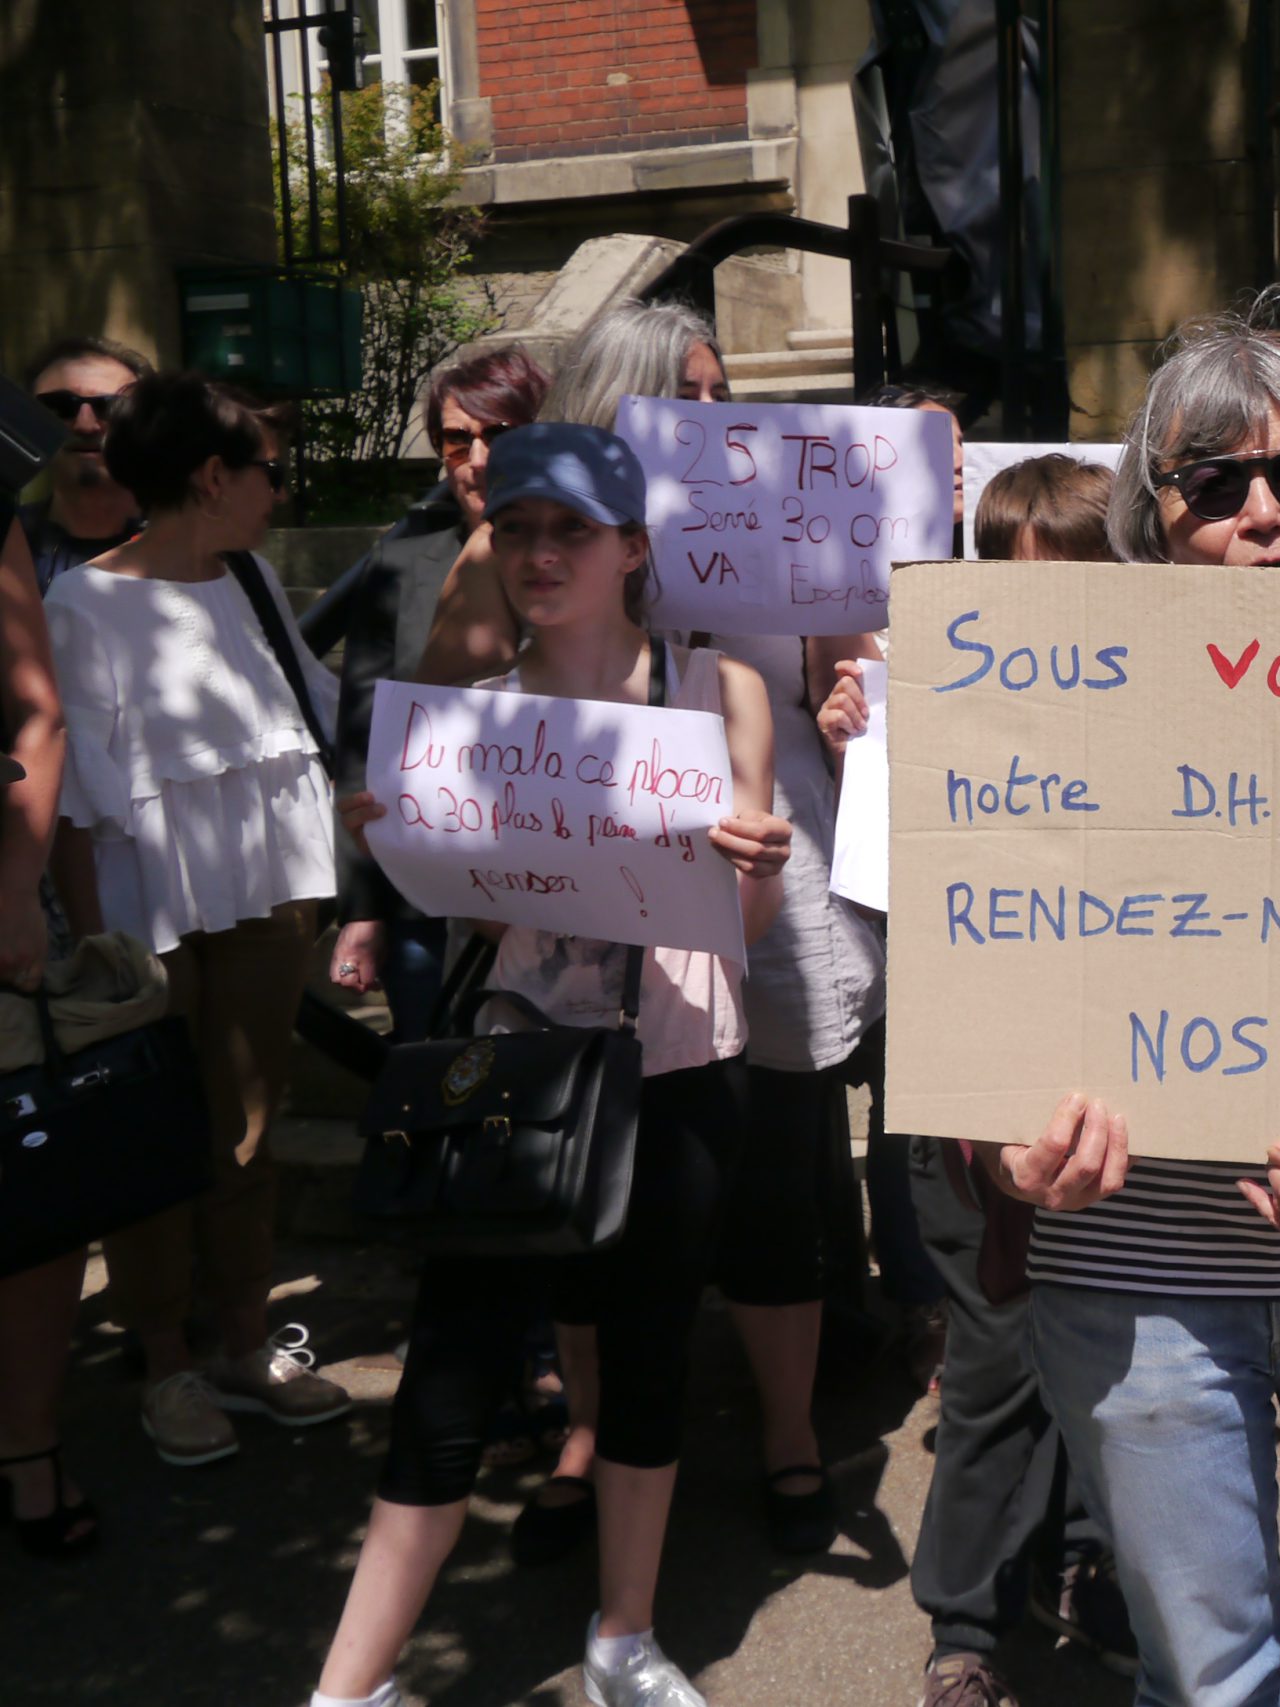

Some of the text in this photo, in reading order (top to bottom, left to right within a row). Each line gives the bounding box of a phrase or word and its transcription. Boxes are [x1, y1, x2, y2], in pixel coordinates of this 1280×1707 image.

[674, 419, 898, 492] 25 TROP
[782, 496, 831, 543] 30
[688, 552, 739, 585] VA
[401, 701, 445, 771] Du
[576, 754, 618, 787] ce
[437, 786, 483, 832] 30
[945, 754, 1101, 826] notre
[1130, 1010, 1270, 1084] NOS
